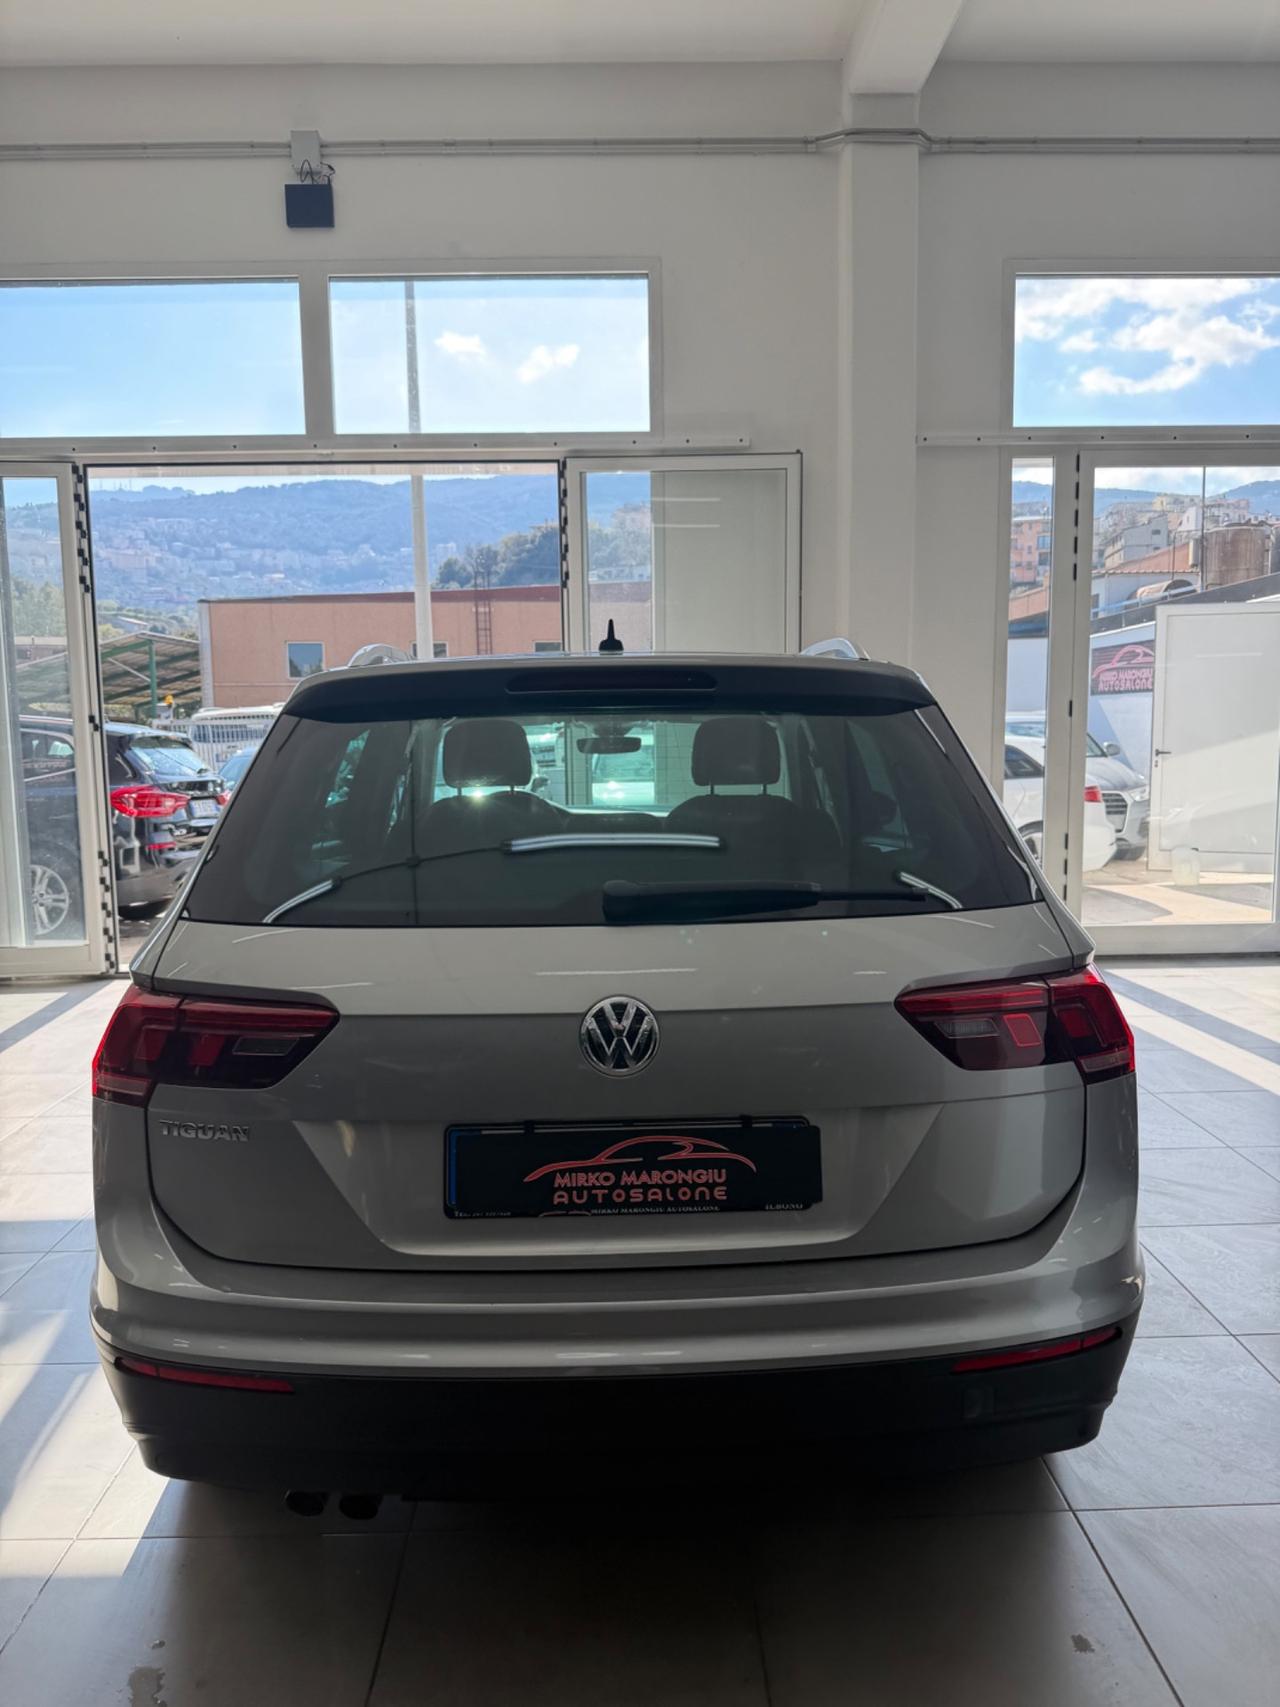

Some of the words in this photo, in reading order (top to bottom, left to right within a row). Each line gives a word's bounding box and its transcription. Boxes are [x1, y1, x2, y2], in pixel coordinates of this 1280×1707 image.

[158, 1119, 249, 1142] TIGUAN
[553, 1171, 616, 1188] MIRKO
[620, 1169, 727, 1186] MARONGIU
[553, 1186, 728, 1205] AUTOSALONE
